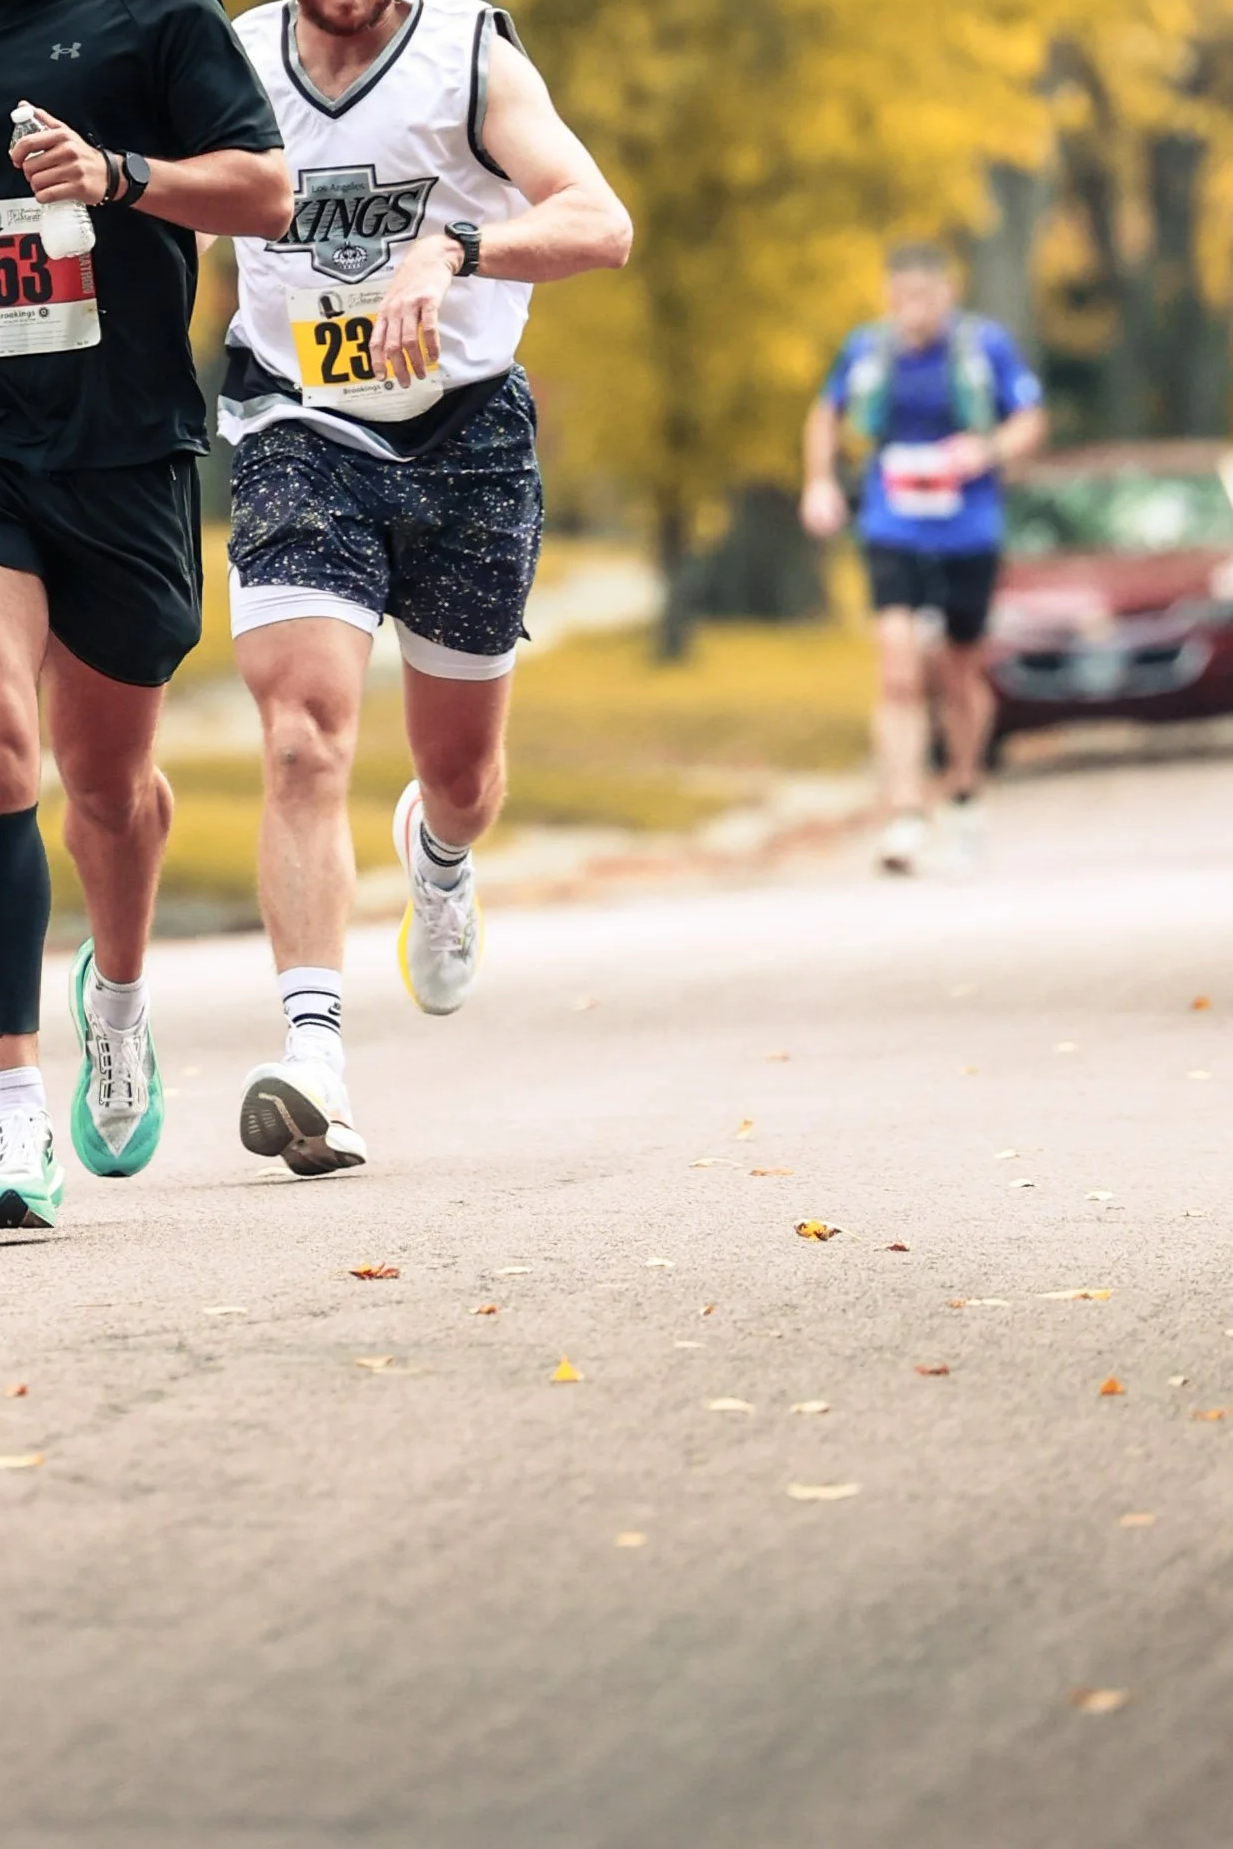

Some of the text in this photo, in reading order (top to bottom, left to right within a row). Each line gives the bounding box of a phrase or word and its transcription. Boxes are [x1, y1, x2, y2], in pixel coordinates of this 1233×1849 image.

[312, 181, 365, 195] Los Angeles
[278, 191, 419, 244] KINGS
[314, 316, 376, 384] 23
[343, 384, 381, 395] Brookings
